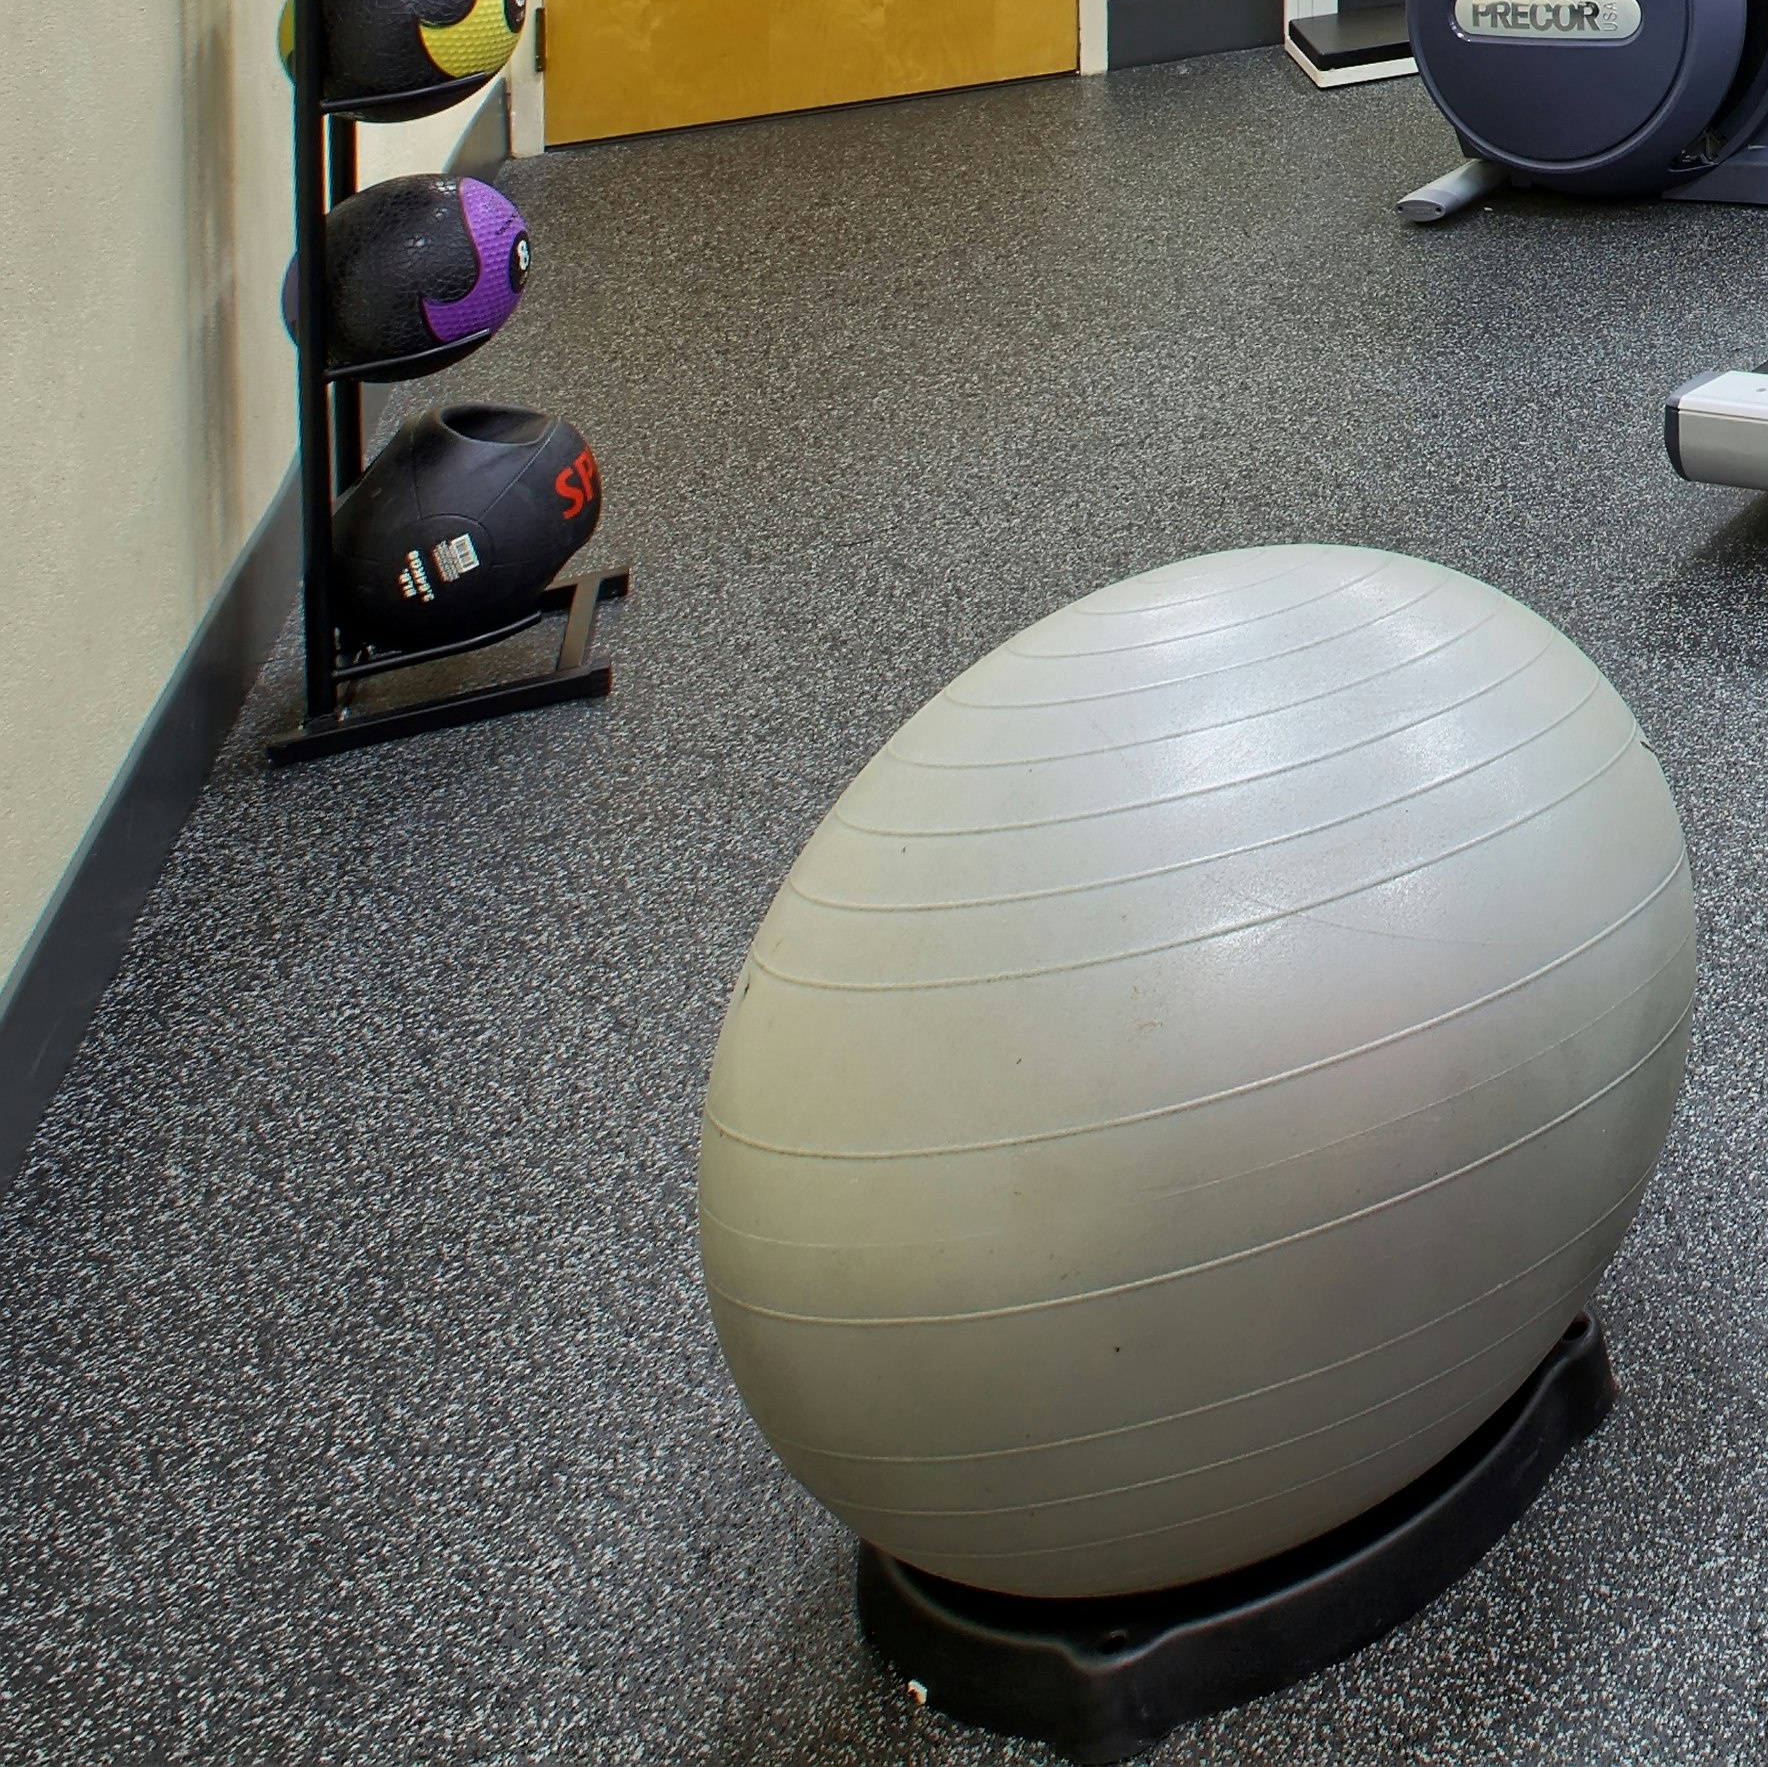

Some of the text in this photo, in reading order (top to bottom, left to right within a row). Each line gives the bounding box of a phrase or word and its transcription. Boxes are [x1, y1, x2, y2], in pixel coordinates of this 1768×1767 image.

[1602, 0, 1618, 32] USA
[517, 239, 530, 271] 8
[555, 445, 598, 520] SP
